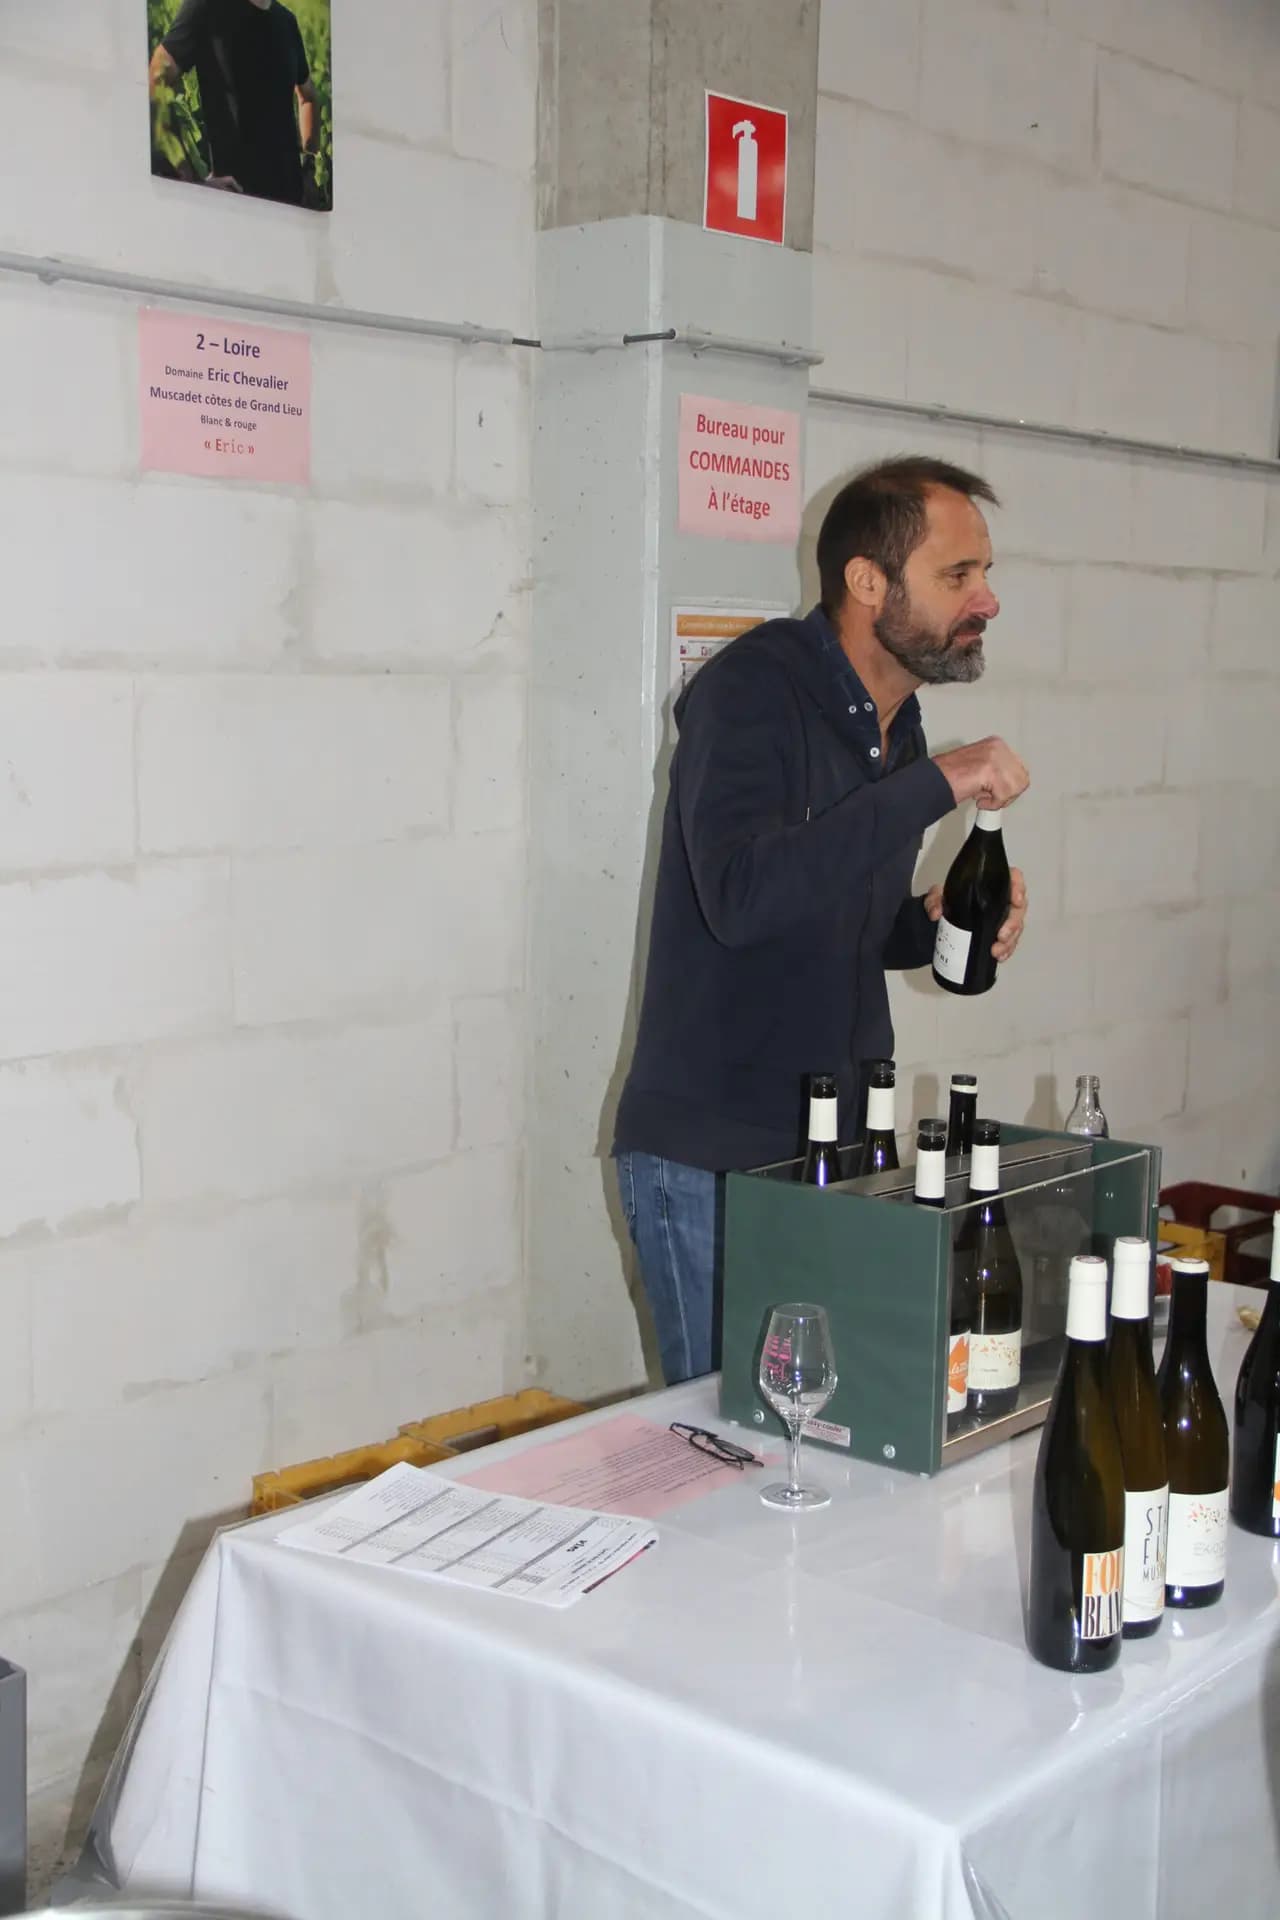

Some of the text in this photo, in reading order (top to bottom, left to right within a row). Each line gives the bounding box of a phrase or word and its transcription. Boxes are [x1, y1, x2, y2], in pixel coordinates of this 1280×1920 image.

[196, 333, 205, 351] 2
[223, 337, 261, 359] Loire
[165, 365, 289, 391] Domaine Eric Chevalier
[150, 386, 303, 417] Muscadet côtes de Grand Lieu
[200, 414, 257, 432] Blanc & rouge
[696, 413, 785, 446] Bureau pour
[689, 449, 790, 481] COMMANDES
[707, 485, 719, 511] À
